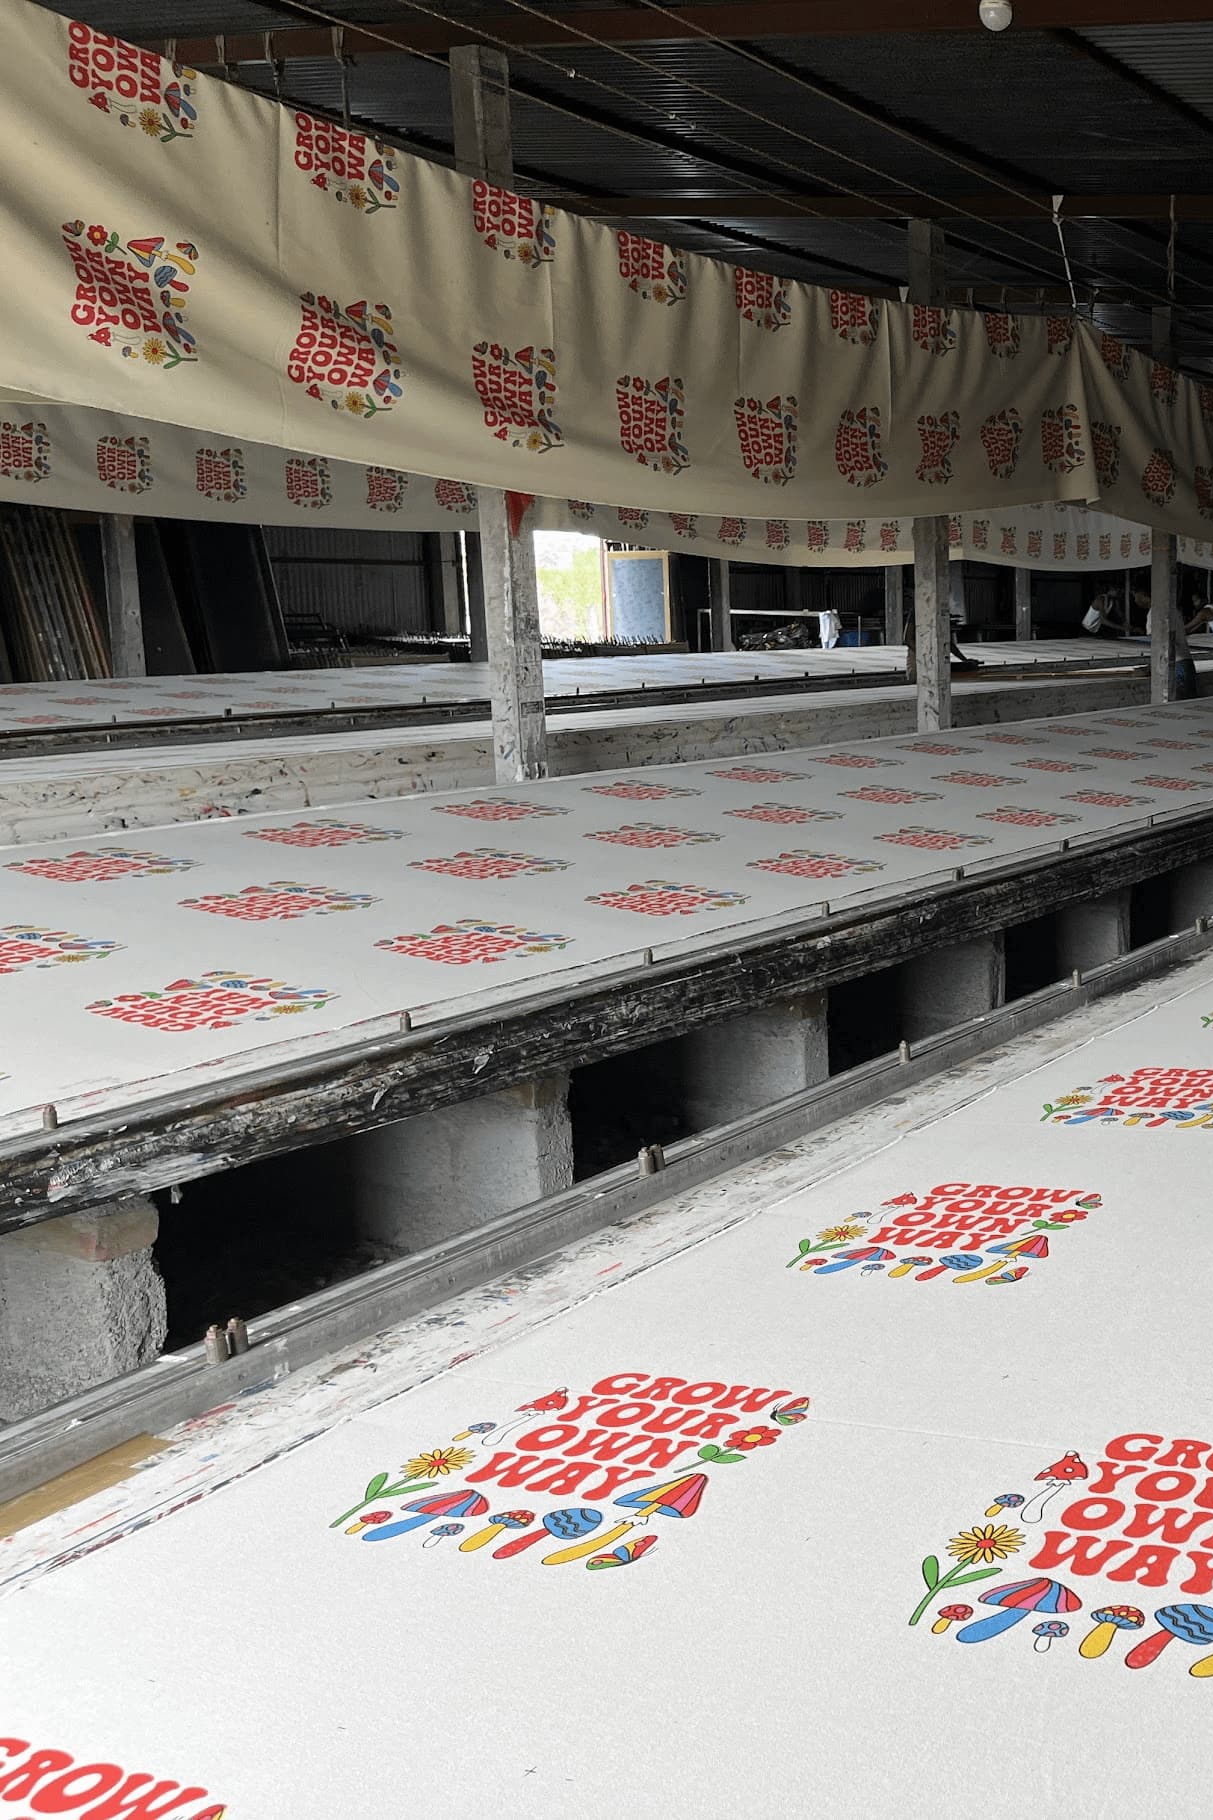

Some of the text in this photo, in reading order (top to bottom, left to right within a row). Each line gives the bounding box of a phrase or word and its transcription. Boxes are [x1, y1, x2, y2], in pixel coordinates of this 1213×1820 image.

[69, 21, 91, 88] GRO
[63, 235, 97, 325] GROW
[86, 248, 119, 326] YOUR
[105, 256, 141, 330] OWN
[127, 263, 162, 333] WAY
[288, 304, 319, 383] GROW
[306, 316, 338, 383] YOUR
[327, 322, 357, 385] OWN
[347, 327, 376, 388] WAY
[472, 355, 498, 427] GROW
[488, 364, 512, 426] YOUR
[503, 368, 526, 427] OWN
[518, 371, 539, 428] WAY
[616, 388, 634, 453] GROW
[631, 395, 644, 453] YOUR
[644, 398, 656, 452] OWN
[655, 400, 667, 452] WAY
[734, 409, 753, 469] GROW
[747, 414, 763, 467] YOUR
[759, 417, 773, 465] OWN
[770, 418, 783, 465] WAY
[97, 445, 107, 481] GROW
[107, 448, 117, 480] YOUR
[117, 450, 127, 480] OWN
[126, 451, 137, 480] WAY
[380, 945, 472, 965] GROW
[409, 940, 489, 960] YOUR
[430, 936, 508, 953] OWN
[451, 932, 528, 949] WAY
[91, 1007, 197, 1032] GROW
[129, 1000, 223, 1025] YOUR
[158, 994, 249, 1016] OWN
[187, 989, 278, 1010] WAY
[1097, 1095, 1207, 1109] WAY
[915, 1196, 1053, 1218] YOUR
[931, 1183, 1084, 1203] GROW
[867, 1227, 1007, 1251] WAY
[893, 1211, 1030, 1234] OWN
[592, 1372, 791, 1412] GROW
[557, 1395, 739, 1439] YOUR
[516, 1424, 699, 1468] OWN
[464, 1451, 655, 1500] WAY
